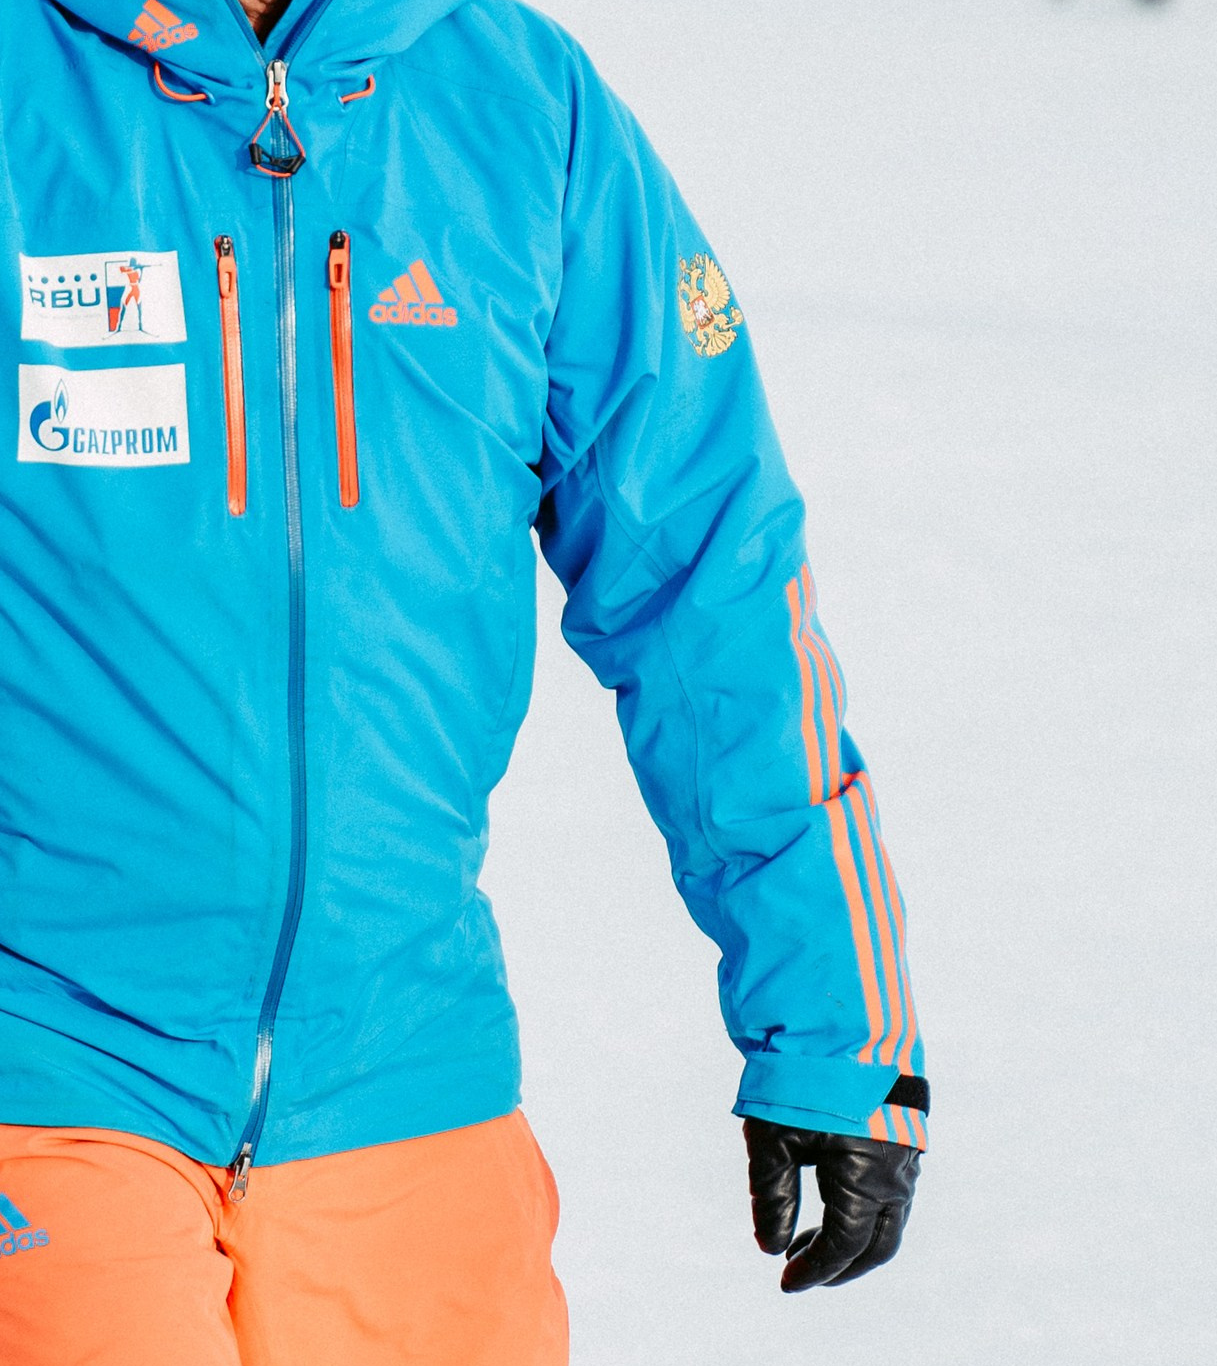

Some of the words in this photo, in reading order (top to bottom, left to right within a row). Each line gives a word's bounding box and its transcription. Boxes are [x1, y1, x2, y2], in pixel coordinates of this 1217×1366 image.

[29, 287, 101, 308] RBU
[368, 299, 458, 326] adidas
[73, 425, 177, 455] GAZPROM
